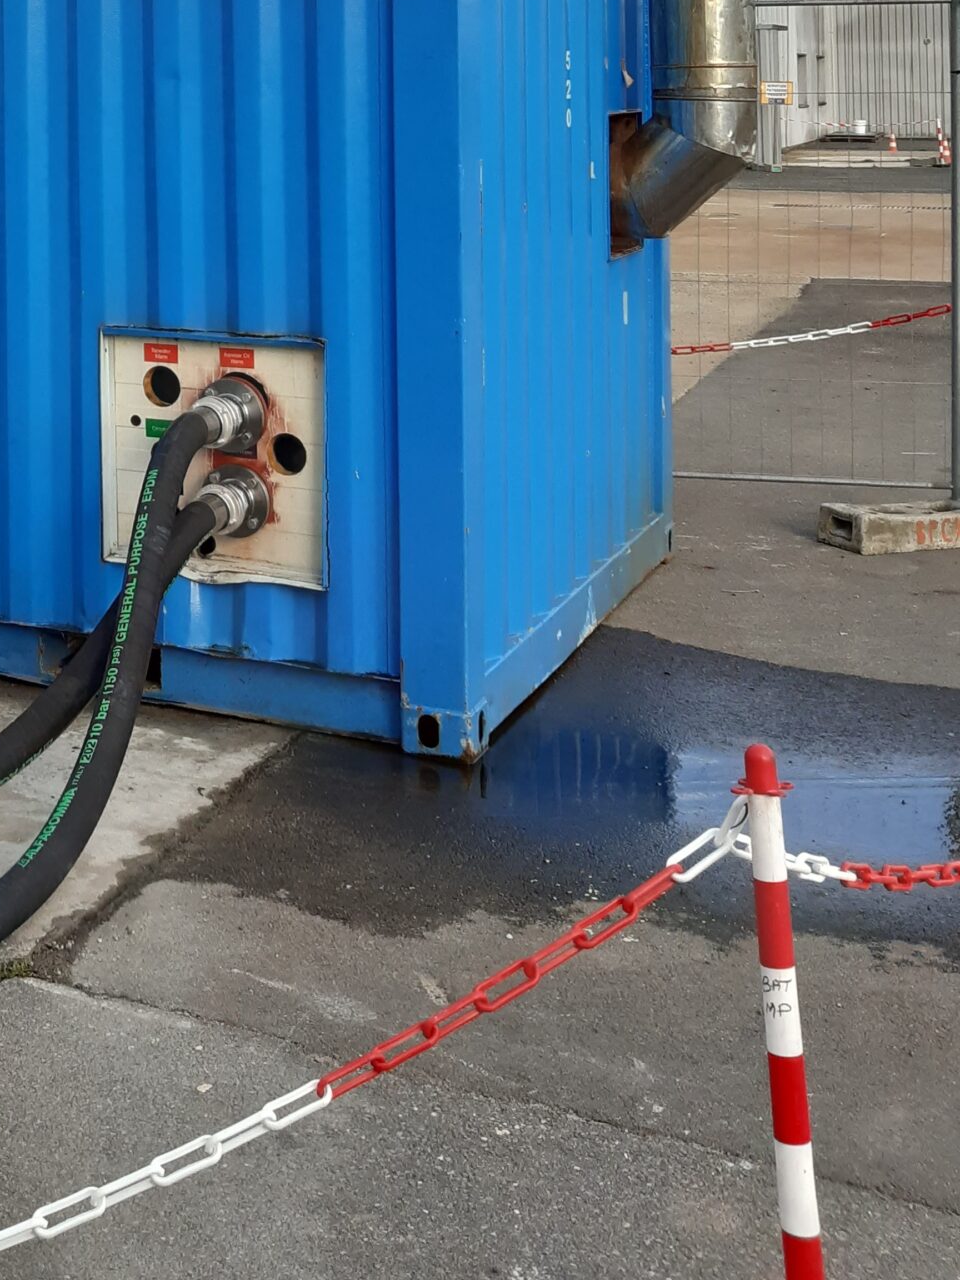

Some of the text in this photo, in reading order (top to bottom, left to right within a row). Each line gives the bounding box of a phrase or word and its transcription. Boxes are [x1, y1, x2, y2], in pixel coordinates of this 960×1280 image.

[141, 468, 159, 503] EPDM
[128, 513, 149, 575] PURPOSE
[115, 578, 137, 642] GENERAL
[95, 692, 111, 719] bar
[90, 723, 104, 737] 10
[72, 764, 87, 786] ITALY
[25, 787, 78, 860] ALFAGOMMA
